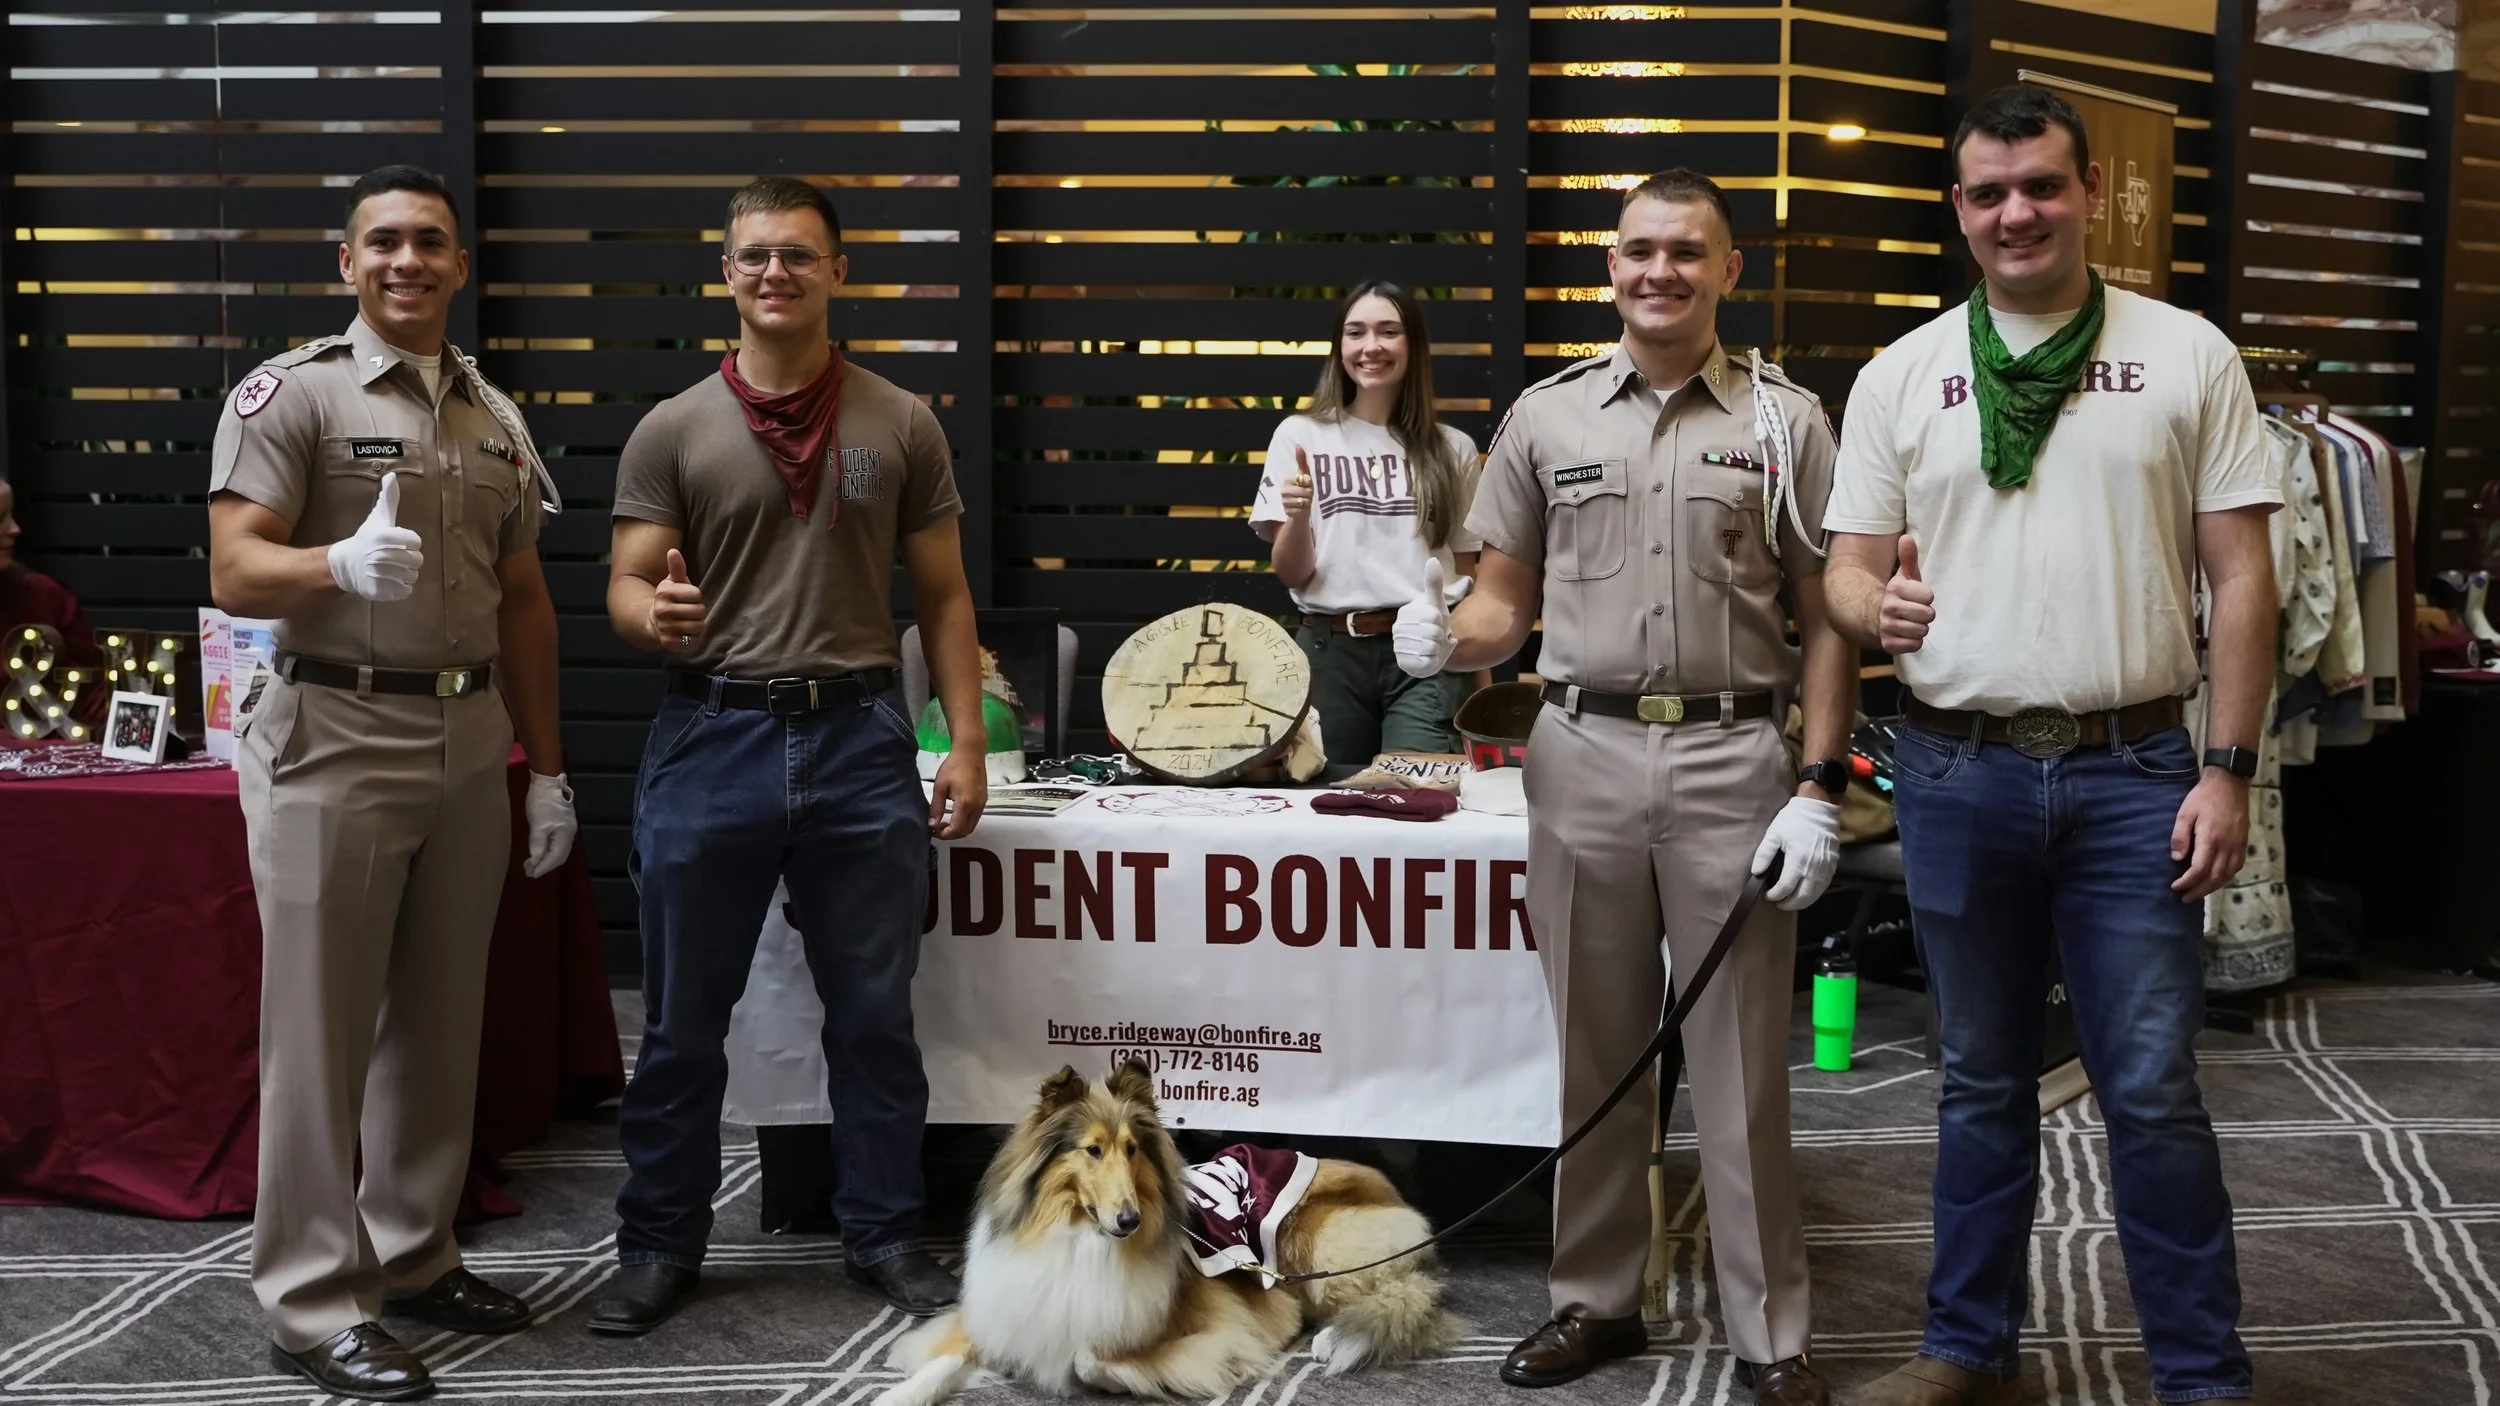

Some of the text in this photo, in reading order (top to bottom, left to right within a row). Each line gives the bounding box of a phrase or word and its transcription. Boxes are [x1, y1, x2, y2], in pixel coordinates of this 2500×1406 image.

[2062, 409, 2078, 417] 1907
[356, 445, 398, 455] LASTOVICA
[1313, 454, 1418, 502] BONFI
[1556, 467, 1602, 482] WINCHESTER
[203, 645, 229, 659] AGGIE
[1133, 614, 1300, 688] AGGIE BONFIRE
[2015, 713, 2073, 732] Copenhagen
[1166, 754, 1213, 771] 2024
[782, 847, 1538, 951] DENT BONFIR
[1048, 1019, 1322, 1050] bryce.ridgeway@bonfire.ag
[1151, 1079, 1260, 1107] .bonfire.ag
